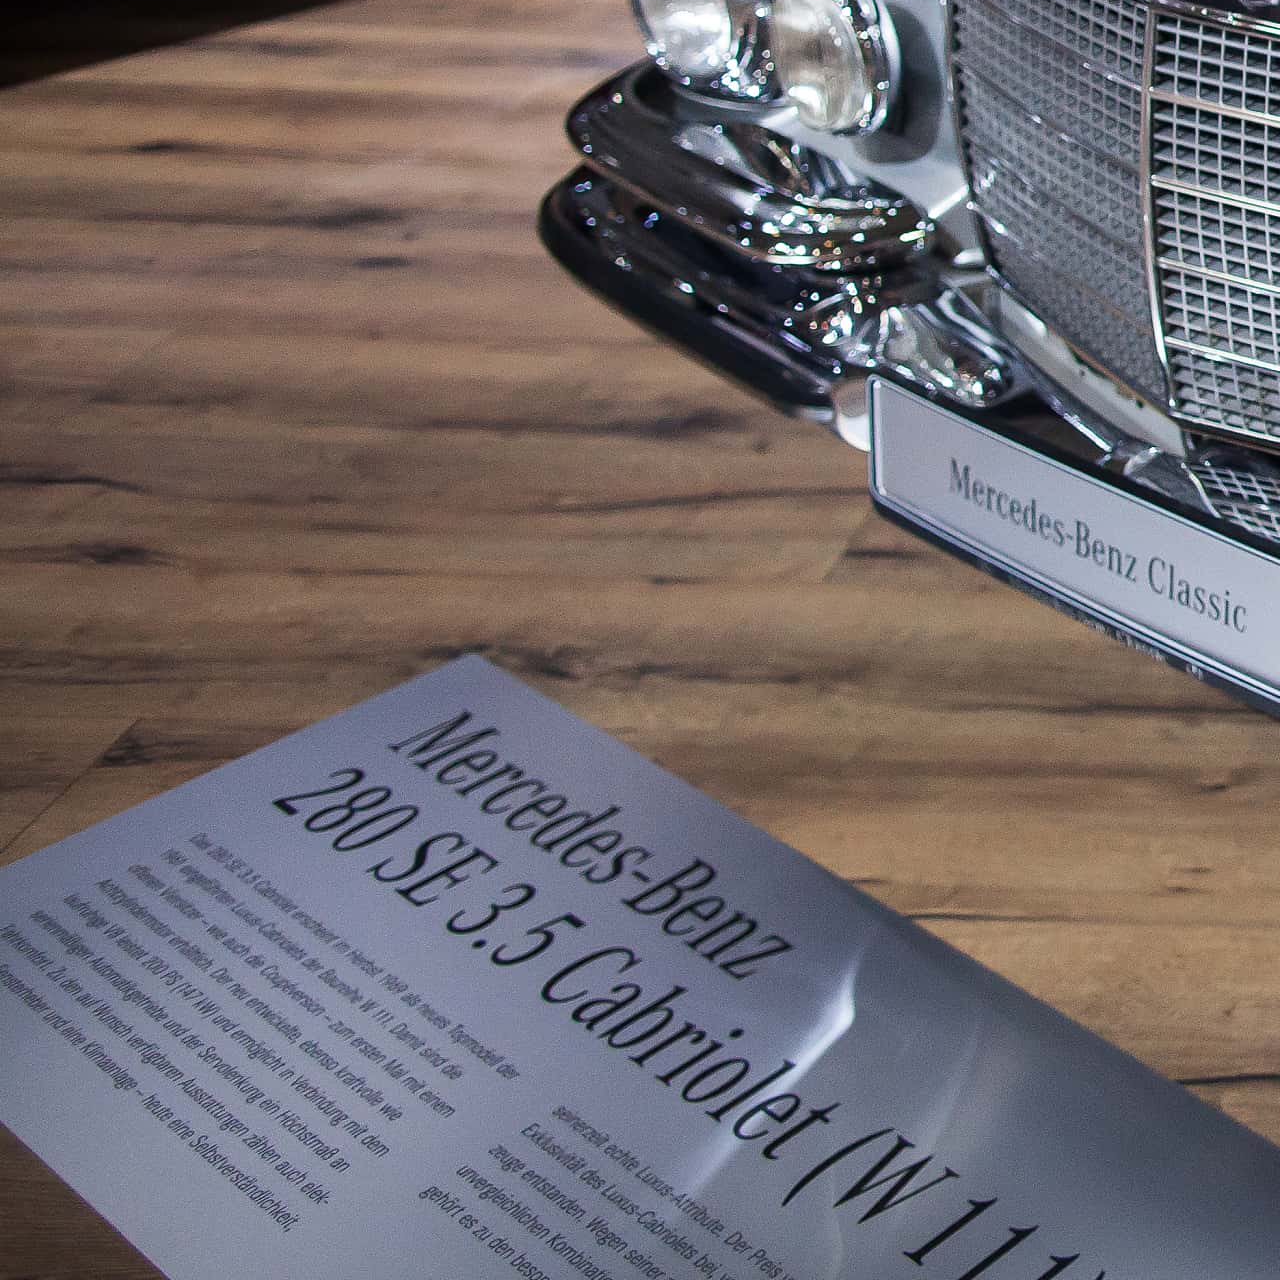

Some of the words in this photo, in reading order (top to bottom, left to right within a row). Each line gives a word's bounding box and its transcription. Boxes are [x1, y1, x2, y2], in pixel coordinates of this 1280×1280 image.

[948, 457, 1139, 584] Mercedes-Benz
[1147, 556, 1248, 634] Classic
[389, 710, 793, 980] Mercedes-Benz
[142, 956, 169, 975] 200
[161, 970, 183, 986] PS
[170, 982, 203, 1000] (147
[272, 767, 418, 852] 280
[367, 832, 498, 908] SE
[446, 883, 586, 966] 3.5
[541, 946, 840, 1161] Cabriolet
[782, 1128, 959, 1223] (W
[193, 997, 219, 1019] kW)
[210, 967, 233, 985] Der
[228, 983, 251, 1001] neu
[246, 998, 301, 1045] entwickelte,
[299, 1040, 338, 1071] ebenso
[335, 1065, 383, 1106] kraftvolle
[380, 1103, 402, 1121] wie
[212, 1015, 239, 1033] und
[46, 966, 66, 982] Zu
[60, 978, 82, 996] den
[76, 993, 103, 1008] auf
[93, 1003, 133, 1038] Wunsch
[127, 1034, 184, 1082] verfügbaren
[178, 1078, 249, 1137] Ausstattungen
[243, 1134, 281, 1164] zählen
[275, 1161, 307, 1185] auch
[301, 1182, 330, 1205] elek-
[88, 957, 168, 1022] Automatikgetriebe
[163, 1020, 191, 1038] und
[181, 1034, 204, 1050] der
[198, 1046, 264, 1104] Servolenkung
[259, 1099, 280, 1115] ein
[275, 1110, 339, 1161] Höchstmaß
[330, 1158, 350, 1173] an
[231, 1030, 286, 1072] ermöglicht
[279, 1068, 294, 1081] in
[328, 1020, 355, 1041] zum
[350, 1037, 386, 1064] ersten
[383, 1059, 409, 1080] Mal
[402, 1076, 426, 1094] mit
[420, 1091, 455, 1118] einem
[420, 1048, 449, 1068] sind
[441, 1064, 462, 1080] die
[496, 1064, 520, 1080] der
[43, 1011, 71, 1030] und
[61, 1026, 86, 1046] eine
[80, 1041, 137, 1091] Klimaanlage
[142, 1093, 173, 1122] heute
[168, 1119, 194, 1140] eine
[189, 1135, 299, 1233] Selbstverständlichkeit,
[291, 1075, 348, 1127] Verbindung
[343, 1120, 368, 1139] mit
[361, 1135, 389, 1158] dem
[419, 1186, 465, 1218] gehört
[459, 1214, 478, 1229] es
[472, 1226, 493, 1242] zu
[488, 1238, 514, 1259] den
[457, 1165, 550, 1239] unvergleichlichen
[488, 1144, 525, 1173] zeuge
[521, 1170, 586, 1223] entstanden.
[586, 1216, 627, 1253] Wegen
[521, 1123, 586, 1174] Exklusivität
[580, 1170, 605, 1190] des
[601, 1184, 698, 1260] Luxus-Cabriolets
[604, 1144, 639, 1172] echte
[635, 1165, 724, 1238] Luxus-Attribute.
[724, 1231, 752, 1254] Der
[748, 1249, 782, 1279] Preis
